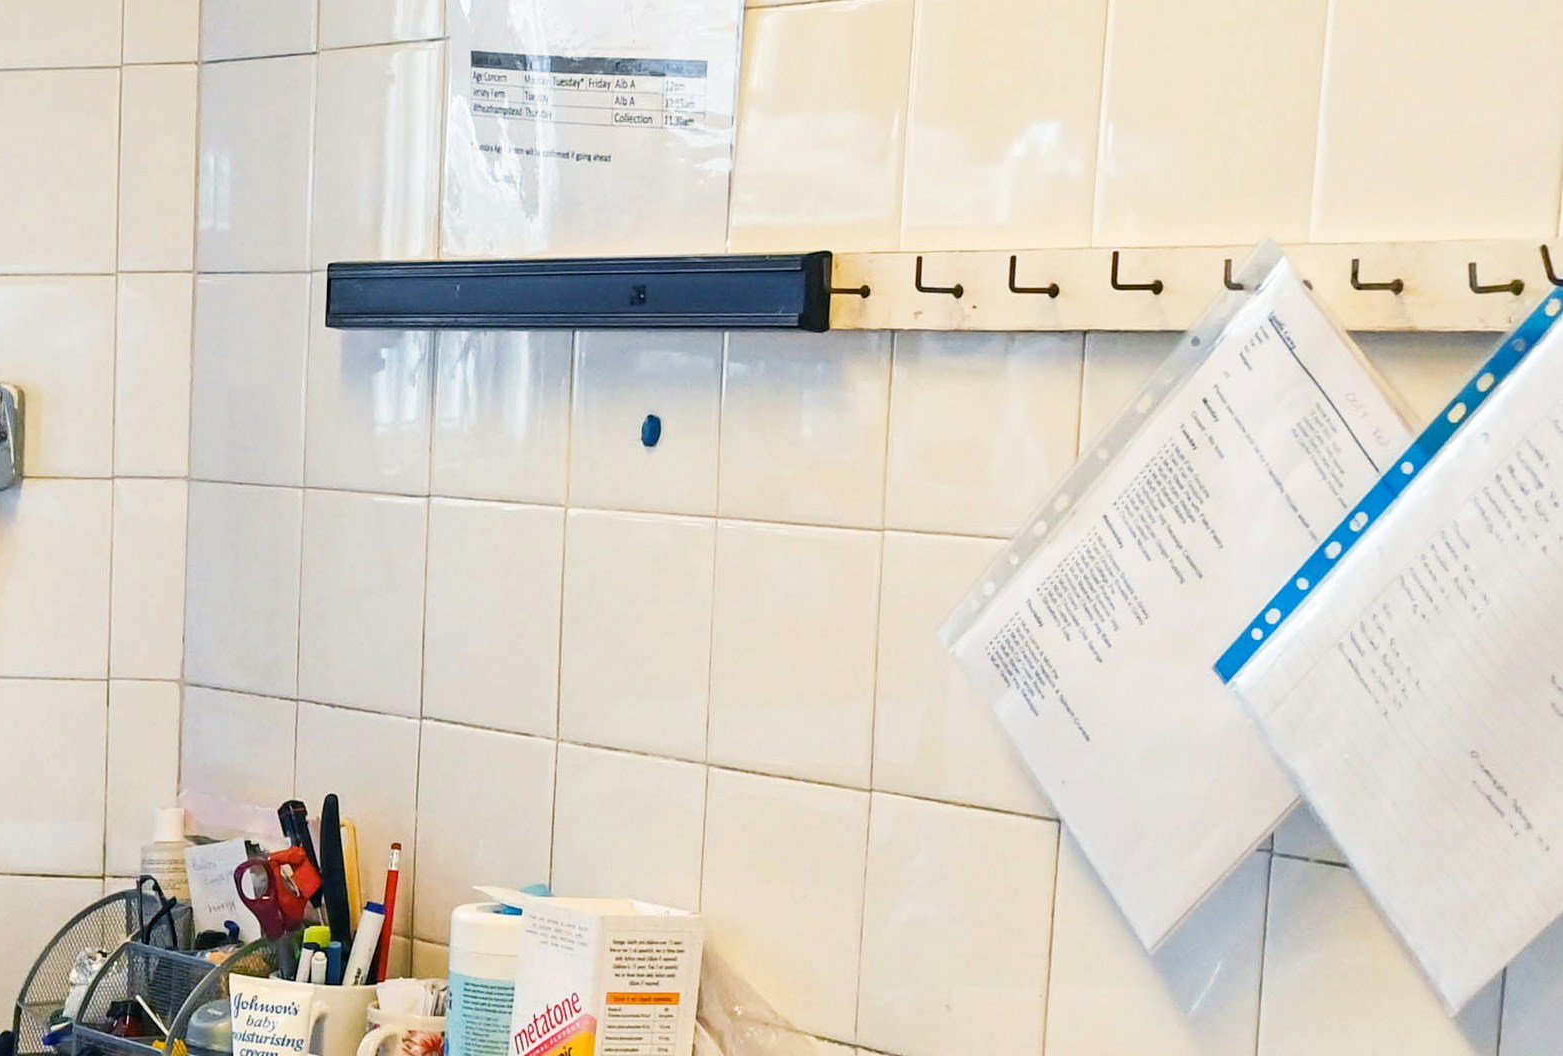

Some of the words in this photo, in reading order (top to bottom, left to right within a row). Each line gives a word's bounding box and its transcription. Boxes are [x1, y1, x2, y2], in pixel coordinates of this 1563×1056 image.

[588, 78, 611, 90] Friday
[615, 79, 628, 89] Alb
[615, 97, 627, 106] Alb
[614, 113, 653, 124] Collection
[233, 993, 299, 1019] Johnson's
[247, 1015, 278, 1031] baby
[514, 992, 582, 1055] metatone
[232, 1030, 304, 1052] oisturising
